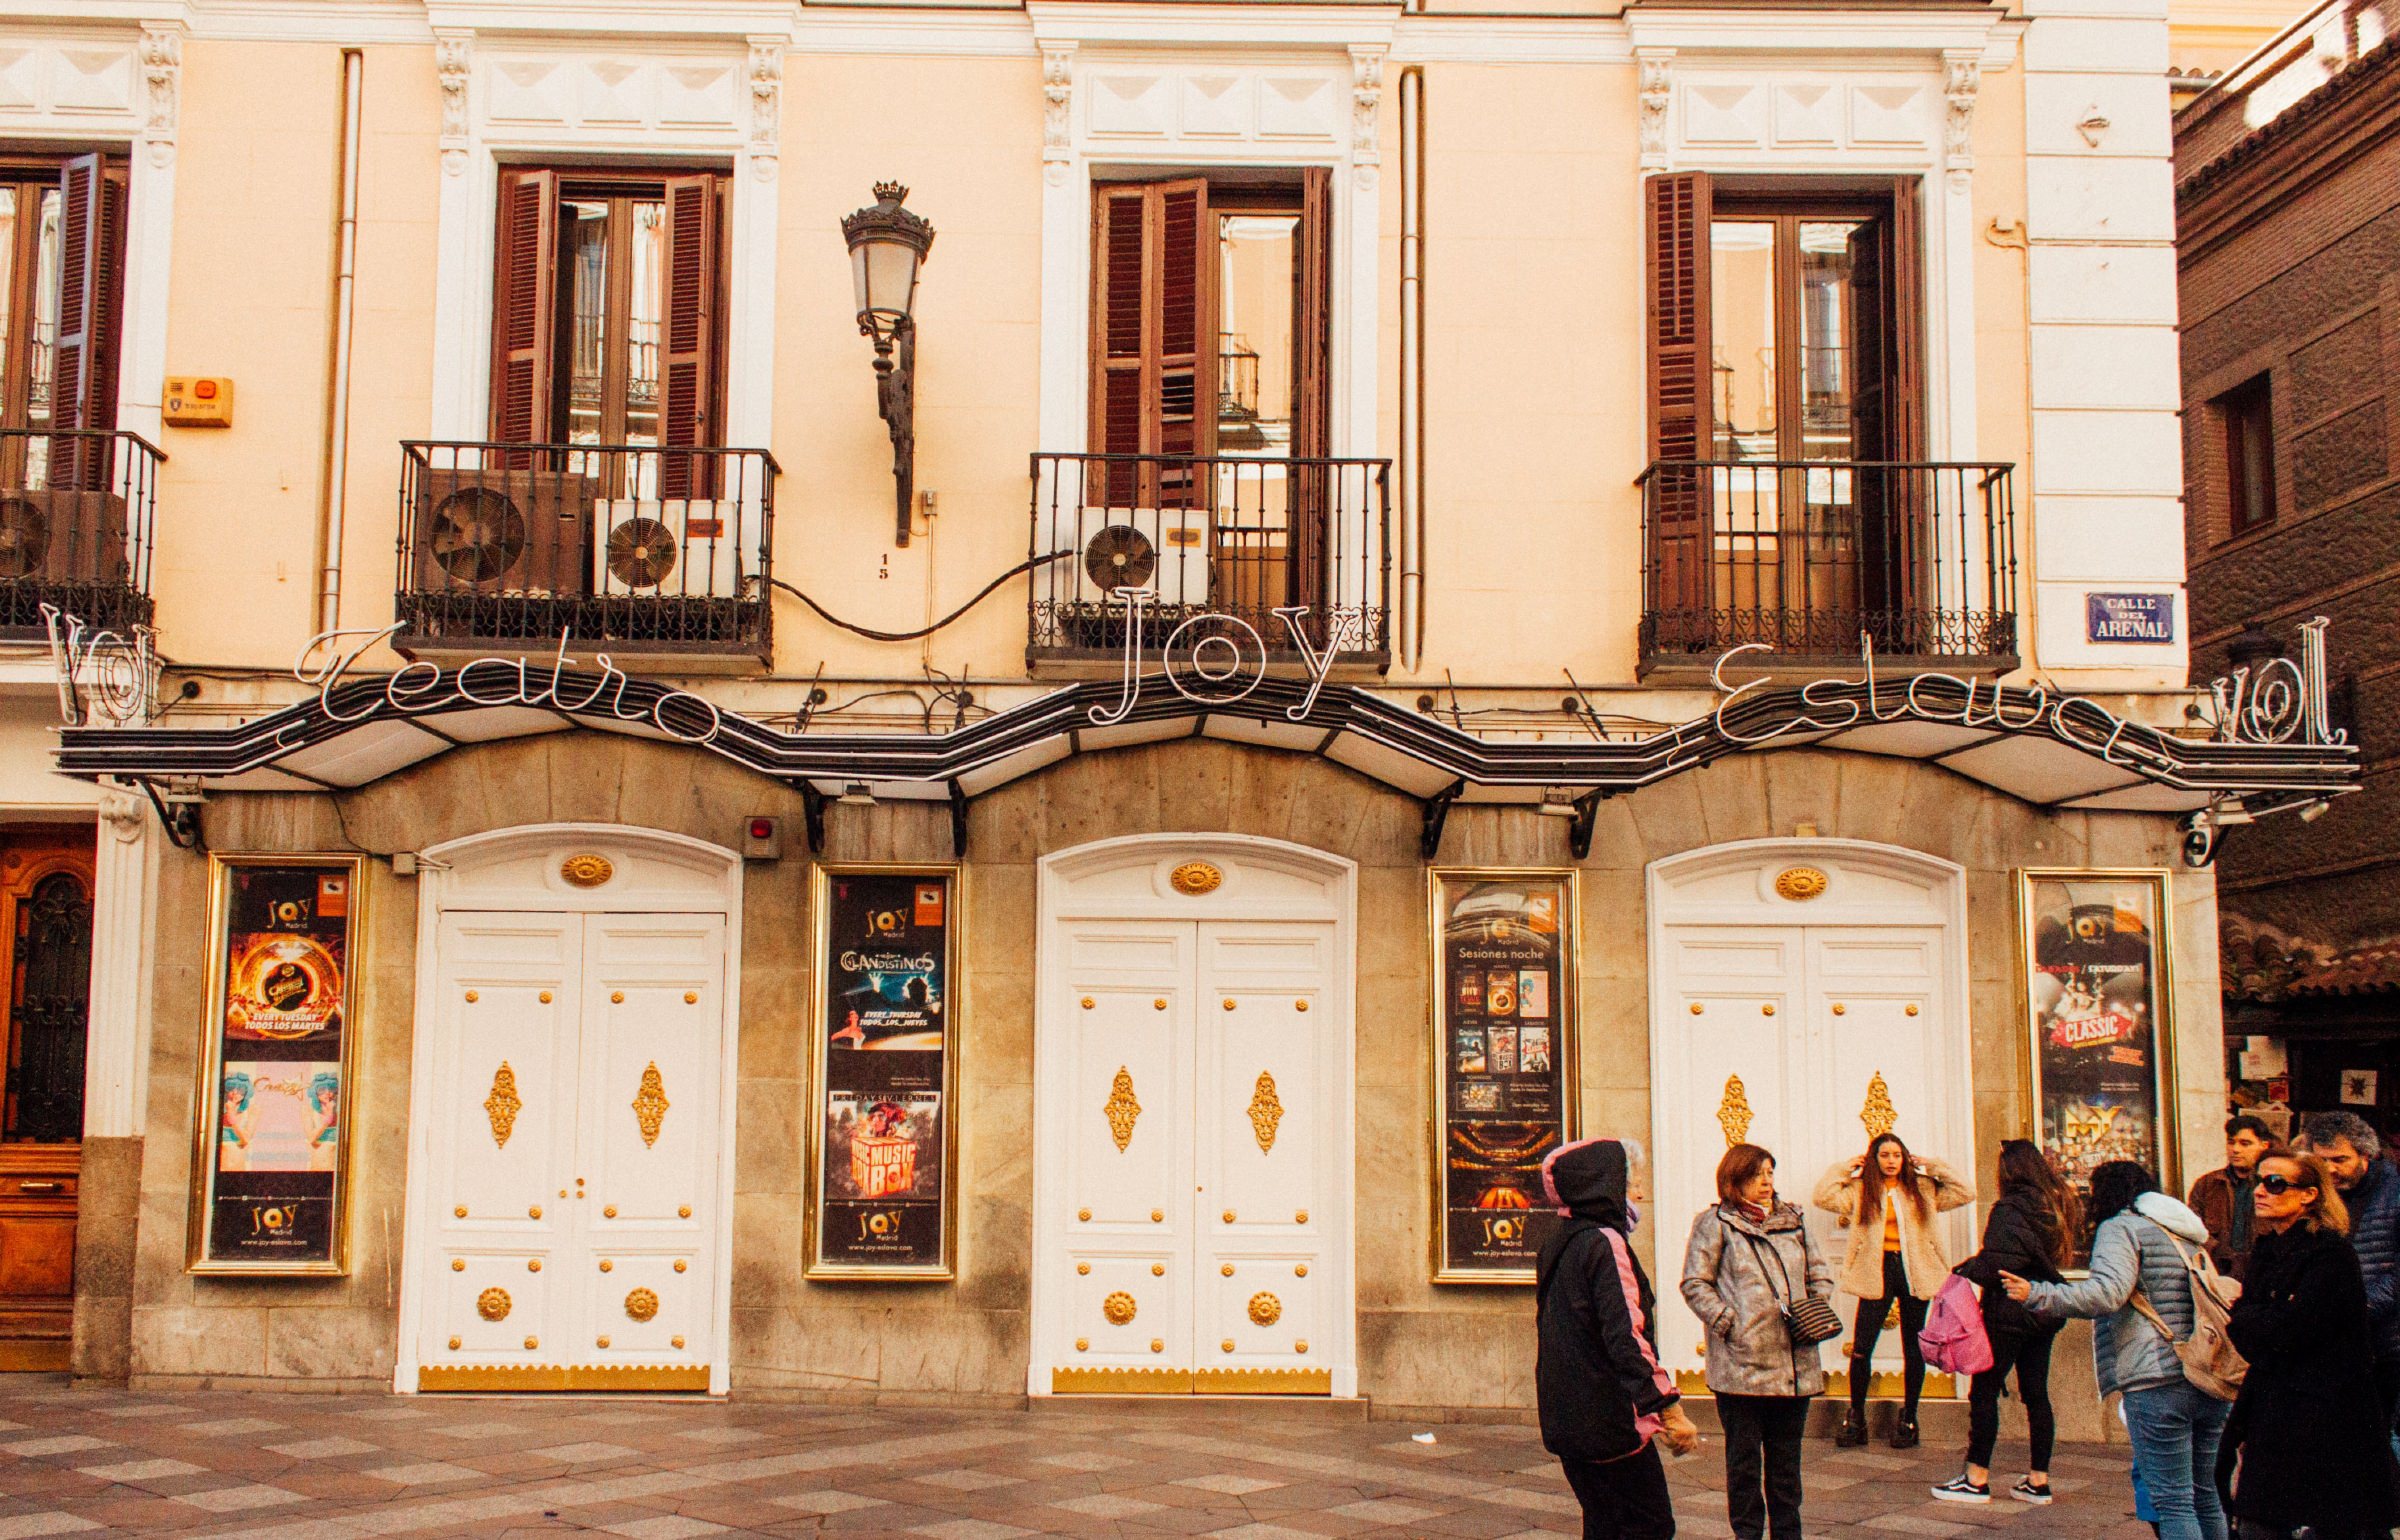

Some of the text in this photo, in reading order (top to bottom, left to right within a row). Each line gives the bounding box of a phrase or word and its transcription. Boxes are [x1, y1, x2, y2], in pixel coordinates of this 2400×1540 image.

[2106, 598, 2156, 610] CALLE
[2119, 611, 2147, 620] DEL
[2096, 620, 2168, 638] ARENAL
[293, 619, 719, 743] Teatro
[1709, 629, 2135, 764] Eslava
[1459, 947, 1544, 959] Sesiones noche
[253, 1013, 317, 1021] EVERY TUESDAY
[245, 1021, 325, 1030] TODOS LOS MARTES
[2065, 1015, 2119, 1043] CLASSIC
[871, 1143, 916, 1166] MUSIC
[871, 1162, 914, 1196] BOX
[876, 1234, 899, 1242] Madrid
